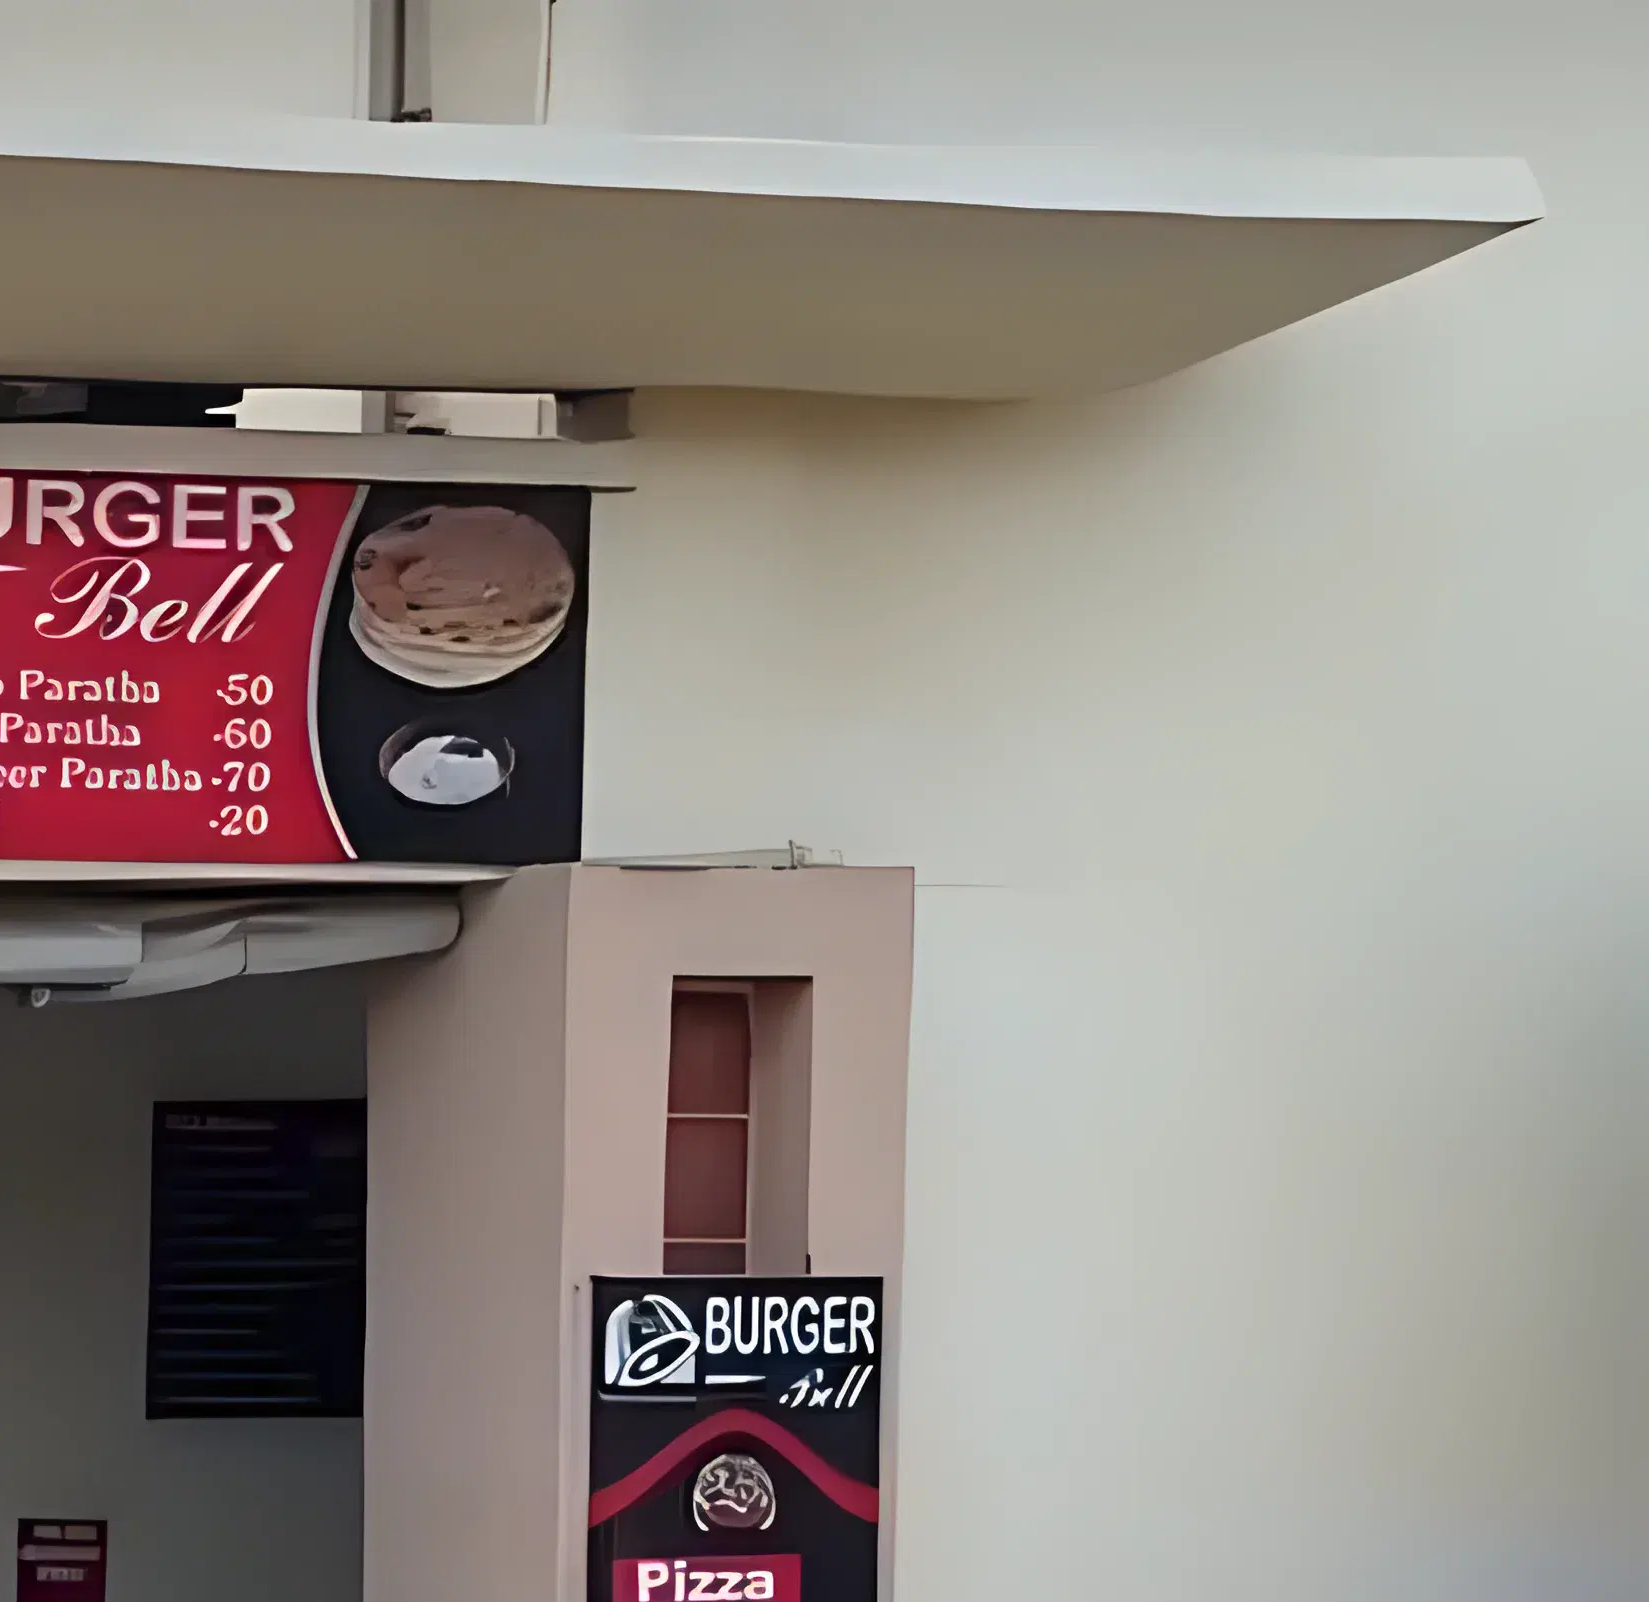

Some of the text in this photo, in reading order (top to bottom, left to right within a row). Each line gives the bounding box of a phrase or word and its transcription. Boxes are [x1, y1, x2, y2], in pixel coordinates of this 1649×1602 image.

[34, 556, 284, 644] Bell
[705, 1295, 876, 1355] BURGER
[637, 1560, 774, 1602] Pizza
